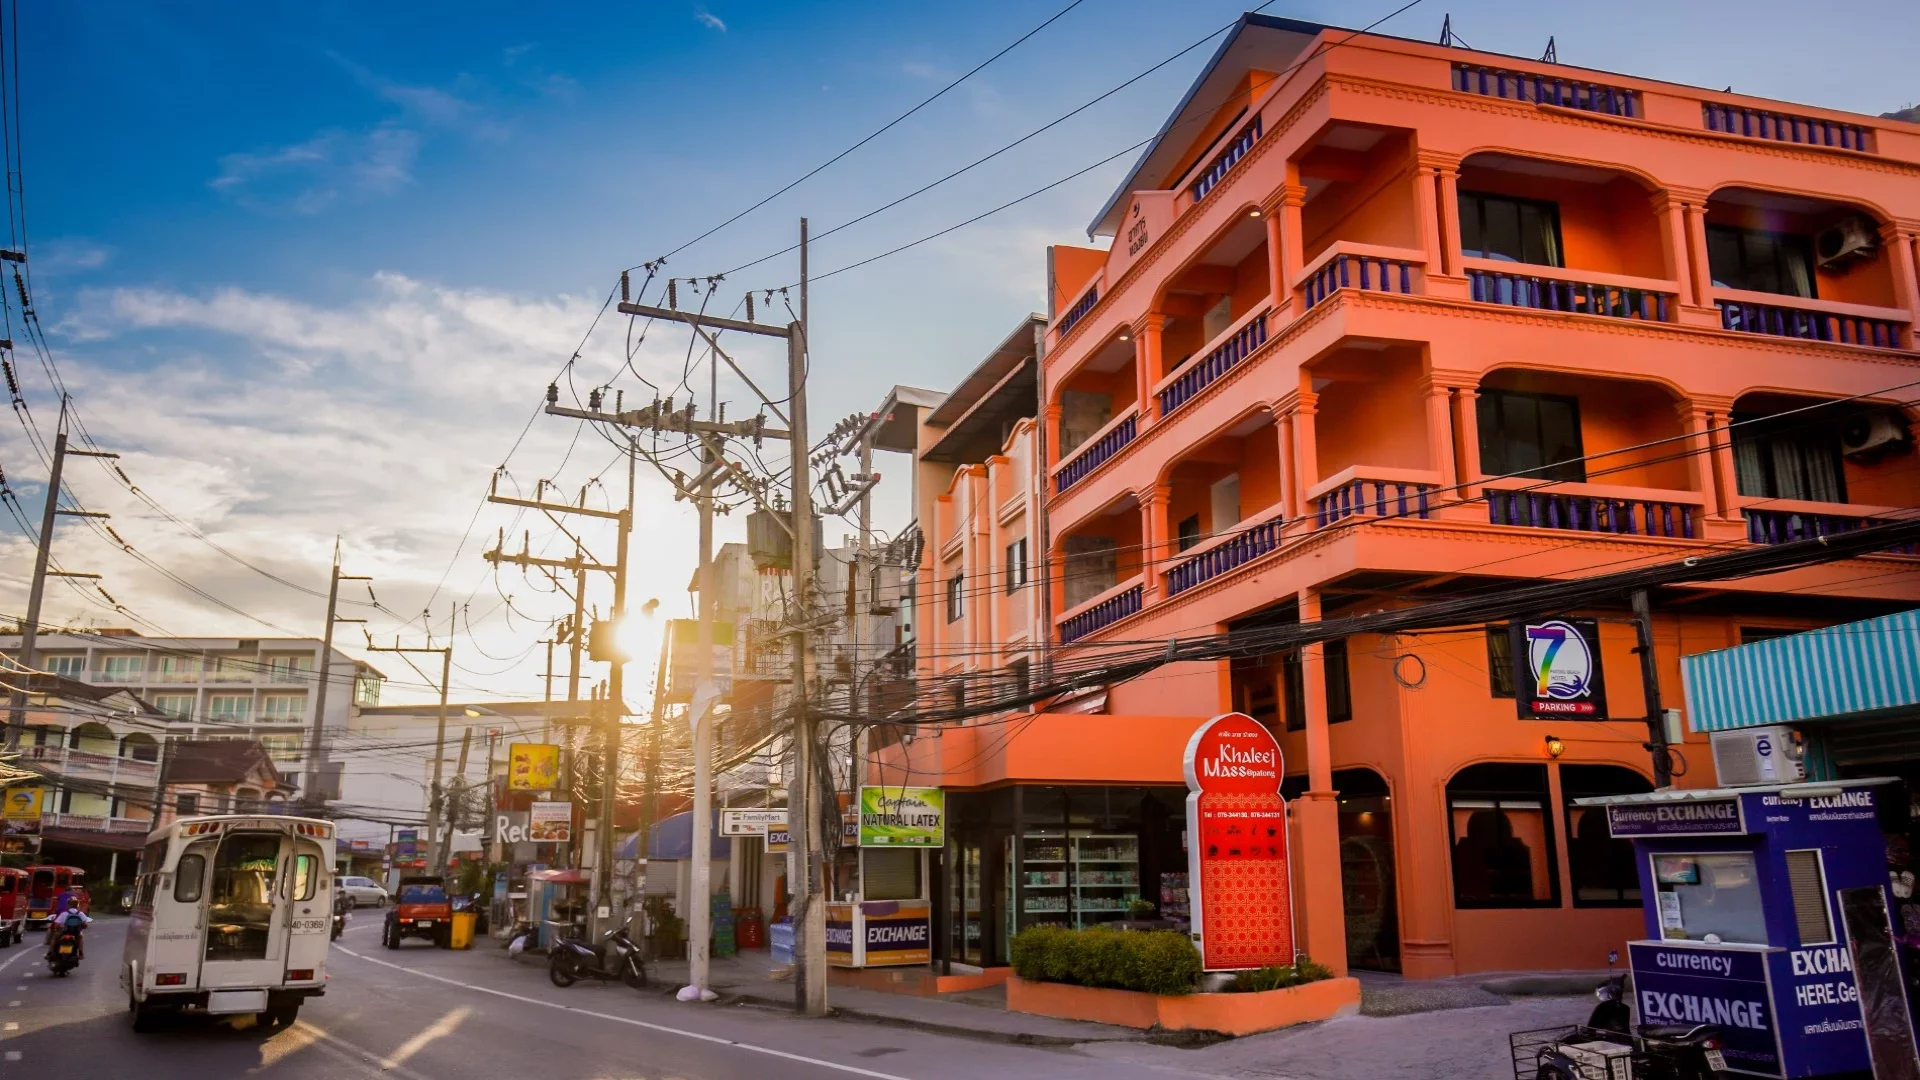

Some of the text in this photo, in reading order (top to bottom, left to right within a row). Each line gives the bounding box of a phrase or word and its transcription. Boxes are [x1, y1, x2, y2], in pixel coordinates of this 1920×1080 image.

[1539, 702, 1576, 712] PARKING
[1220, 743, 1275, 768] Khaleej
[1810, 791, 1873, 808] EXCHANGE
[742, 813, 781, 821] FamilyMart
[863, 813, 940, 827] NATURAL LATEX
[1657, 803, 1737, 821] EXCHANGE
[867, 925, 927, 943] EXCHANGE
[1656, 952, 1732, 976] currency
[1641, 990, 1767, 1030] EXCHANGE
